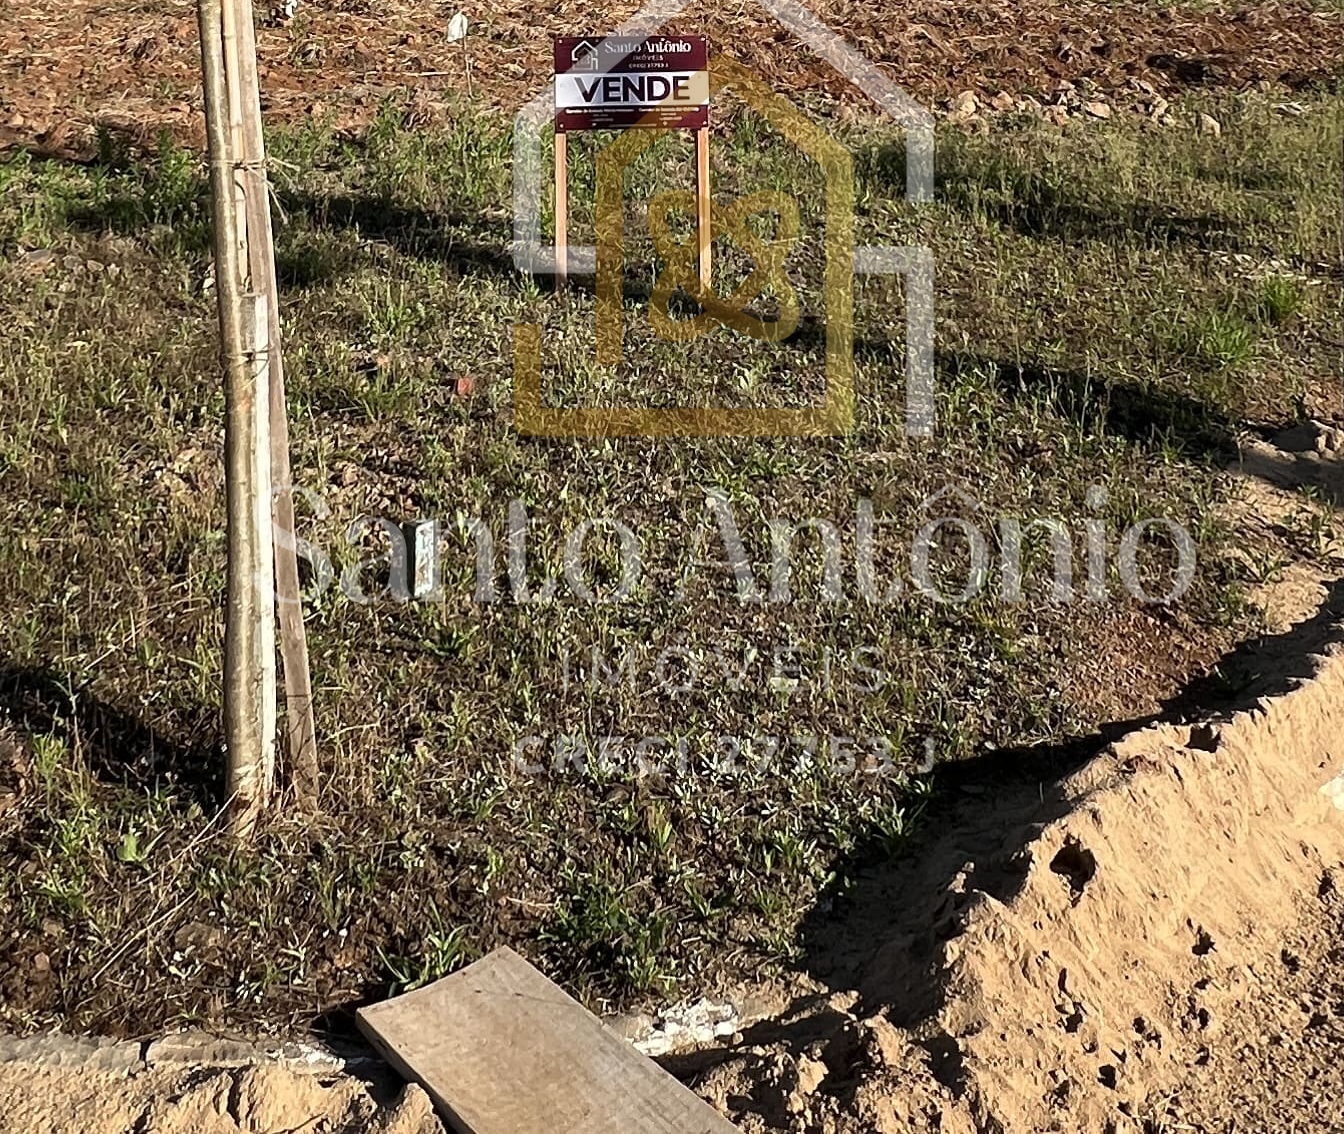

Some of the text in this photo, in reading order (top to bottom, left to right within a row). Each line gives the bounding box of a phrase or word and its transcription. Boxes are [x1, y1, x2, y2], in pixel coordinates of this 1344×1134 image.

[604, 38, 692, 54] Santo Antônio
[574, 75, 690, 103] VENDE
